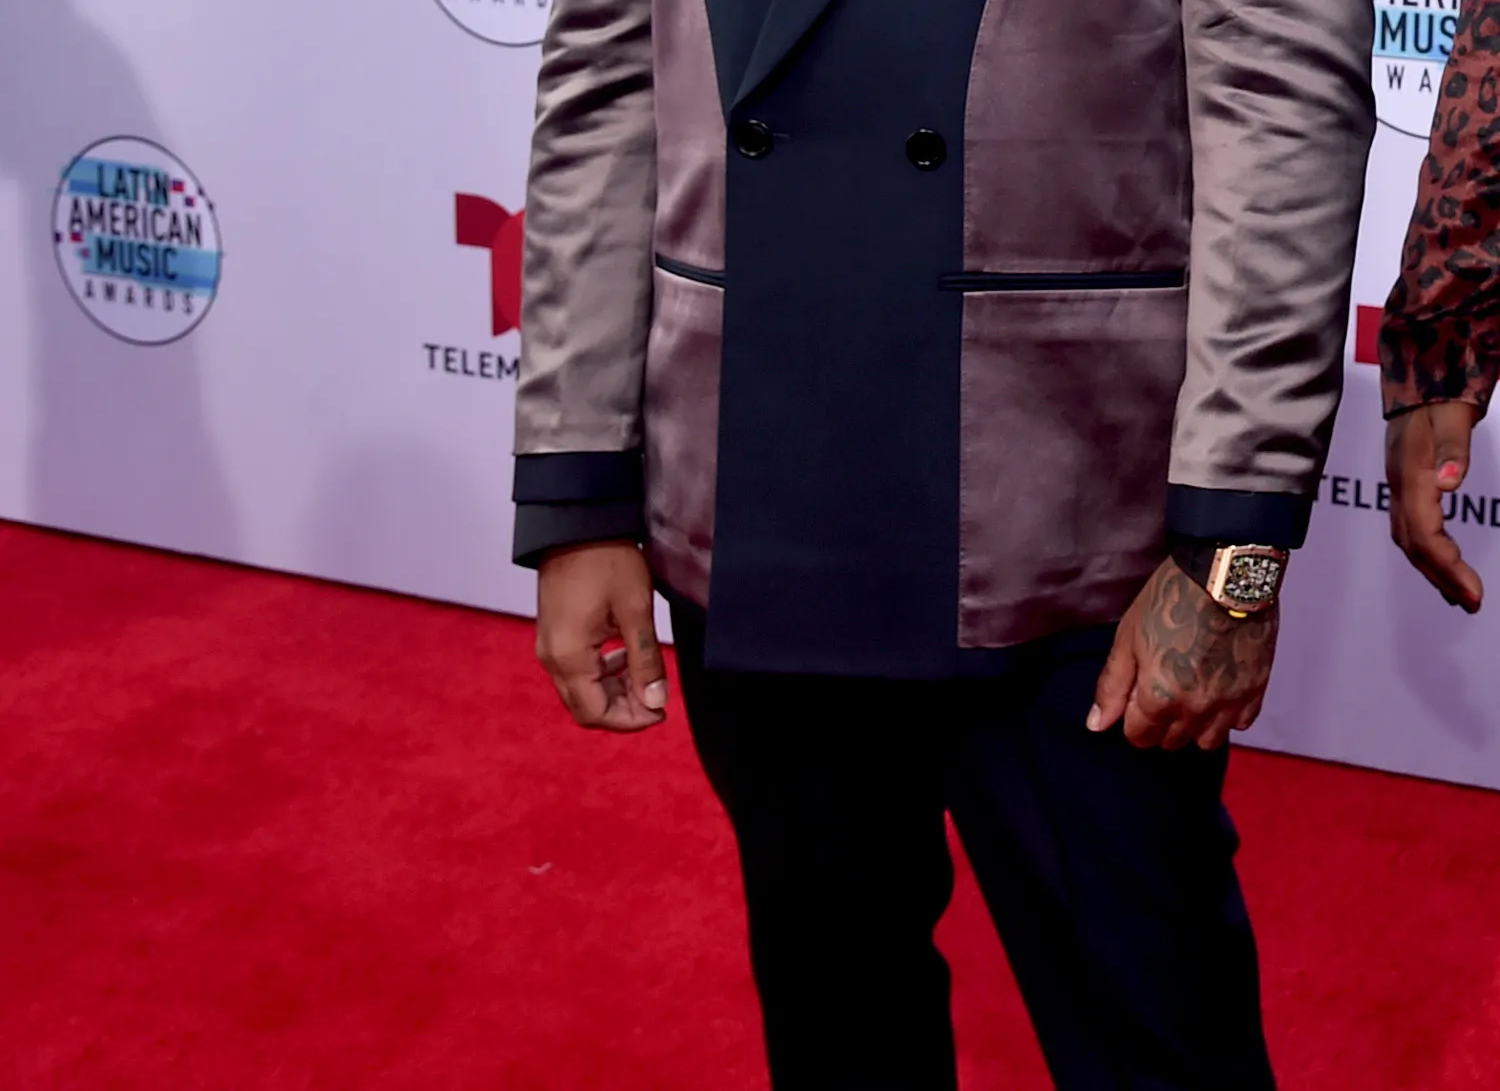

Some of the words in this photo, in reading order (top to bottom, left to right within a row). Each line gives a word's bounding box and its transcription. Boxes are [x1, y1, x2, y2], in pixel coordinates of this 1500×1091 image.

[1380, 10, 1457, 56] MUS
[96, 165, 171, 206] LATIN
[69, 197, 201, 246] AMERICAN
[96, 240, 178, 283] MUSIC
[84, 279, 194, 315] AWARDS
[423, 343, 519, 381] TELEM
